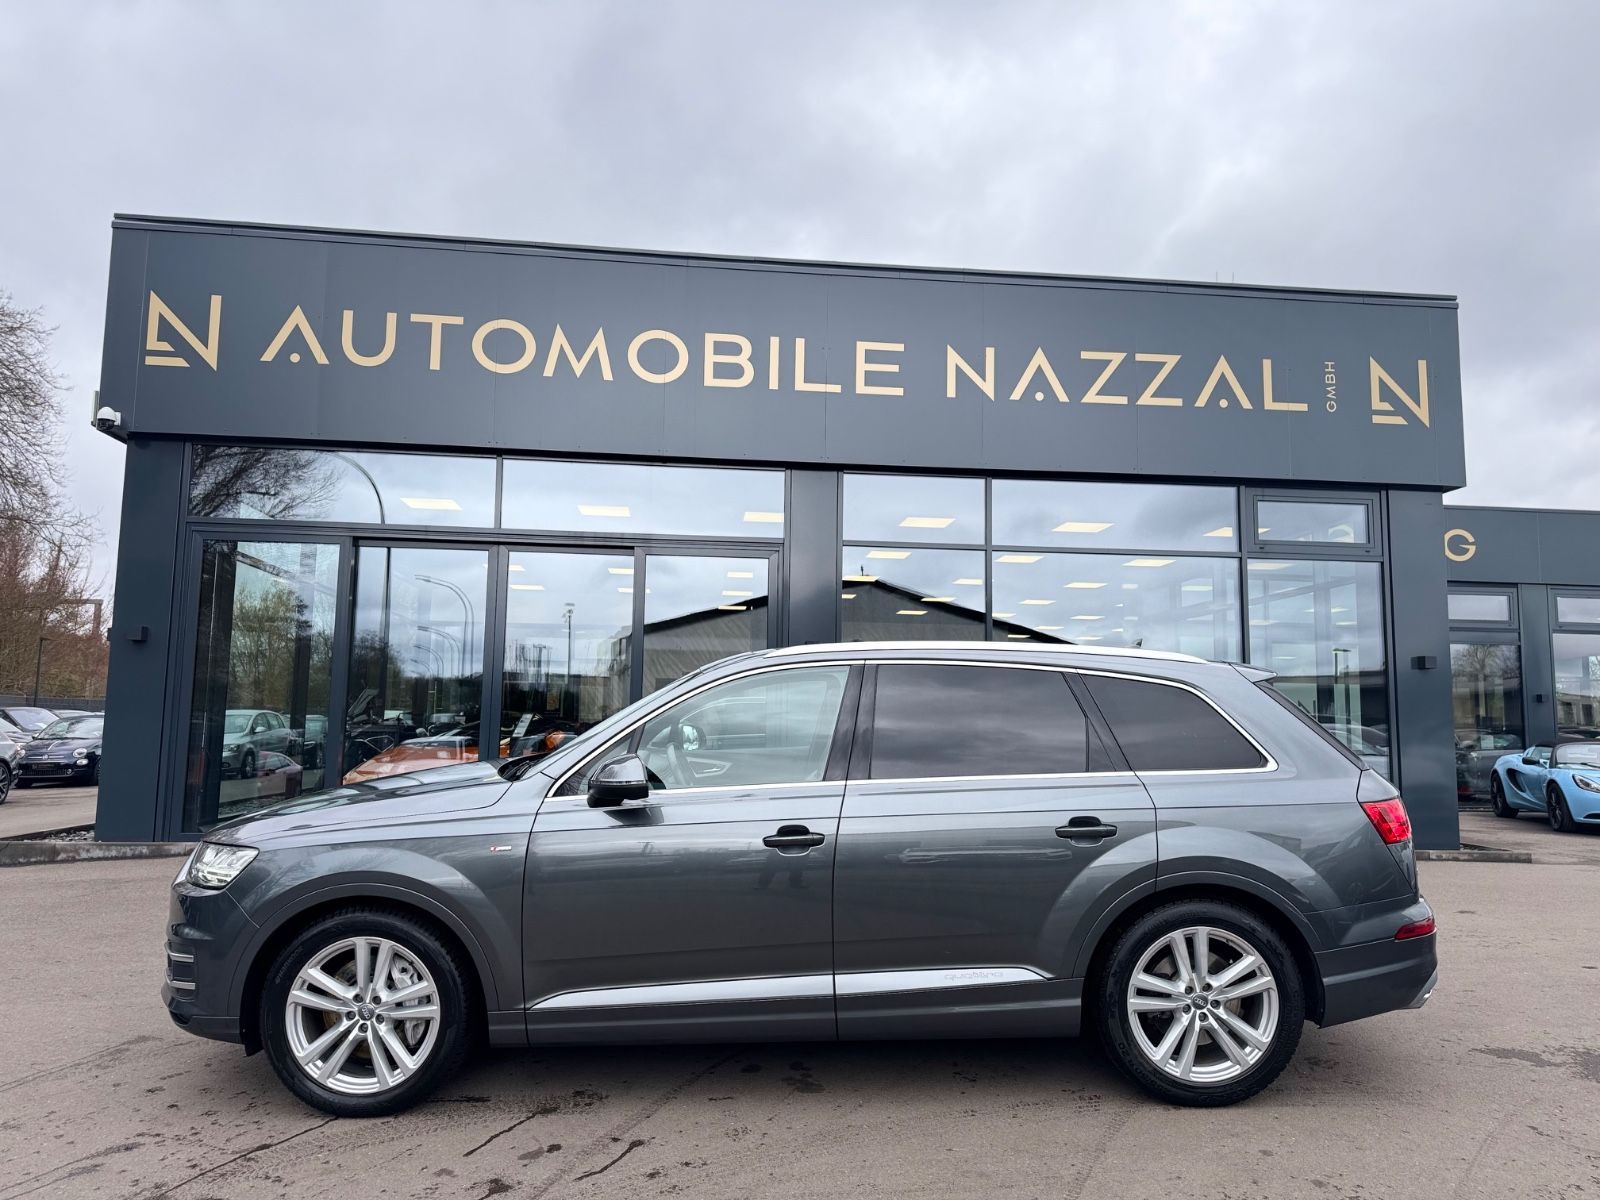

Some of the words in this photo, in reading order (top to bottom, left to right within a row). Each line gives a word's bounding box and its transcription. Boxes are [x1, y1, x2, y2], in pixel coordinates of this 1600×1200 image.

[261, 305, 905, 397] AUTOMOBILE
[946, 346, 1308, 412] NAZZAL
[1324, 361, 1337, 412] GMBH
